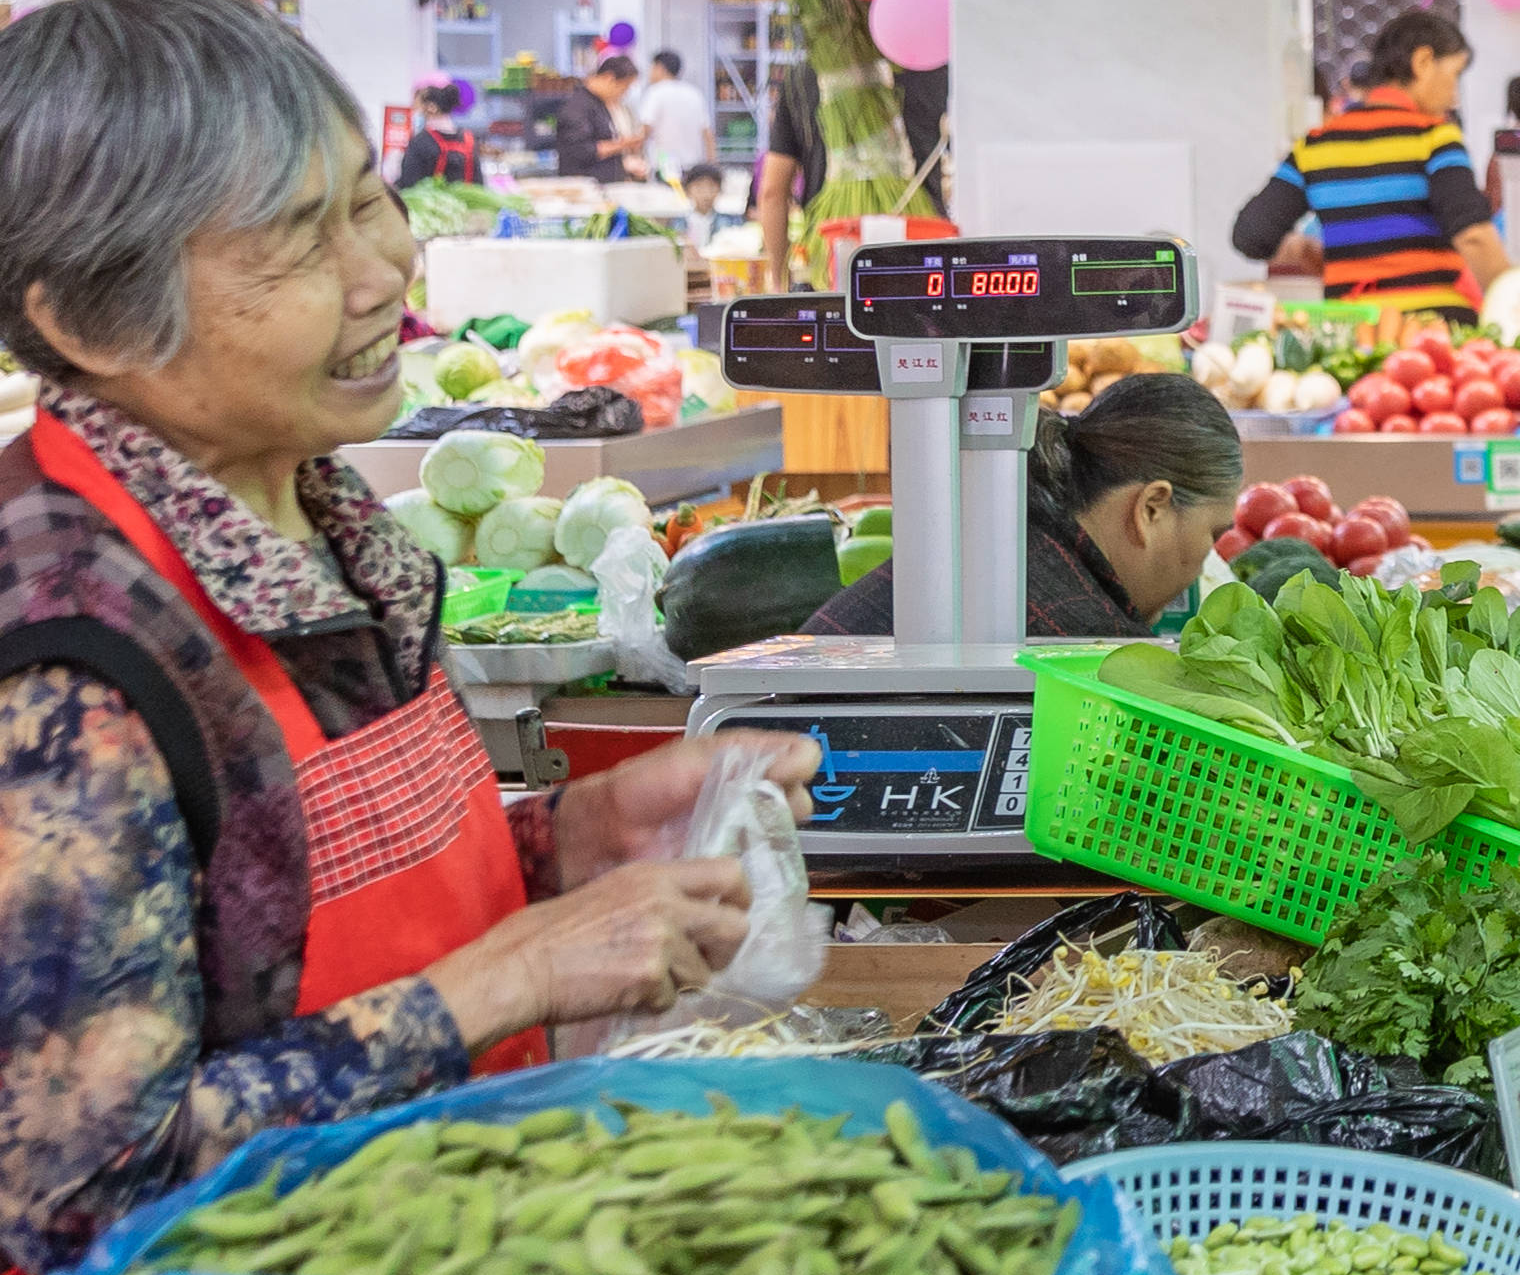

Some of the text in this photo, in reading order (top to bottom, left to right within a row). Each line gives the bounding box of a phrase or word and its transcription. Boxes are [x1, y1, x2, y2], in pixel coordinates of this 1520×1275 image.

[927, 273, 943, 296] 0
[1016, 753, 1029, 767] 4
[1013, 776, 1023, 789] 1
[1005, 796, 1019, 811] 0
